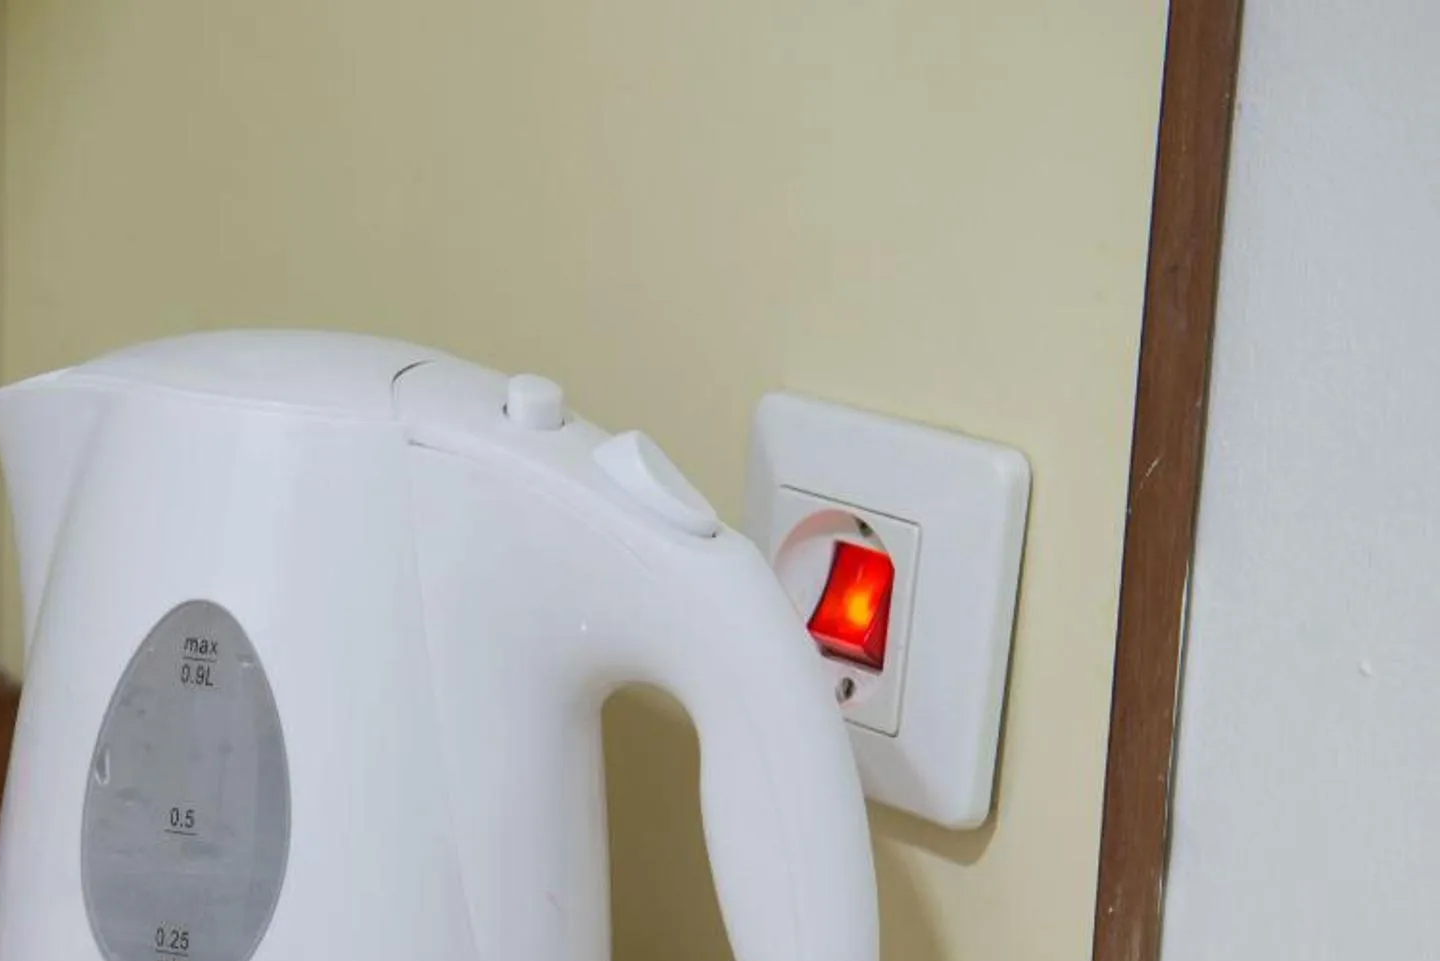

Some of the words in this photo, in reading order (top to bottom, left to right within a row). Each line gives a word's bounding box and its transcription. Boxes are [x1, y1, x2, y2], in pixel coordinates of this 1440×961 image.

[183, 637, 218, 655] max
[180, 663, 213, 686] 0.9L
[170, 807, 195, 828] 0.5
[155, 927, 189, 951] 025
